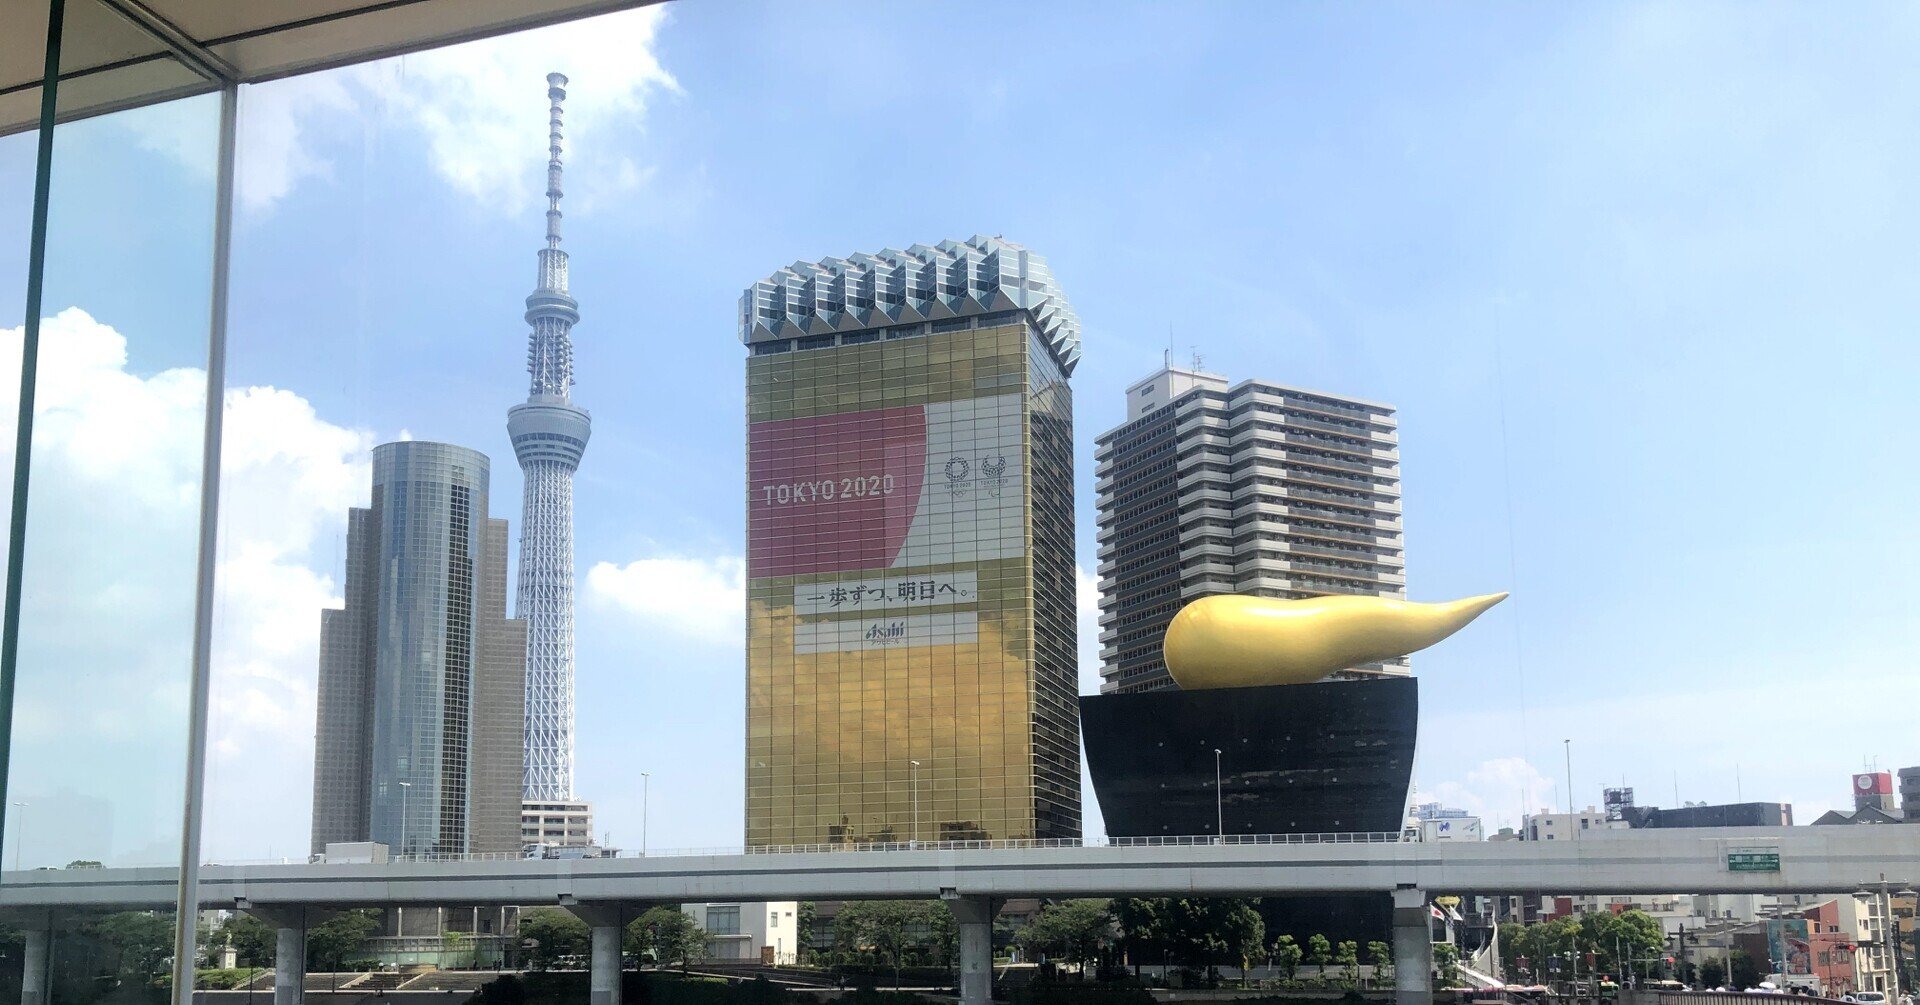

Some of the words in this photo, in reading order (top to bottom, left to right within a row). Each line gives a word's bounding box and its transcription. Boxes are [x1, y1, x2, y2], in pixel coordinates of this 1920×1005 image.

[763, 480, 834, 505] TOKYO
[840, 474, 894, 498] 2020
[807, 581, 968, 607] 一歩ずつ、明日へ。
[865, 621, 904, 639] Asahi
